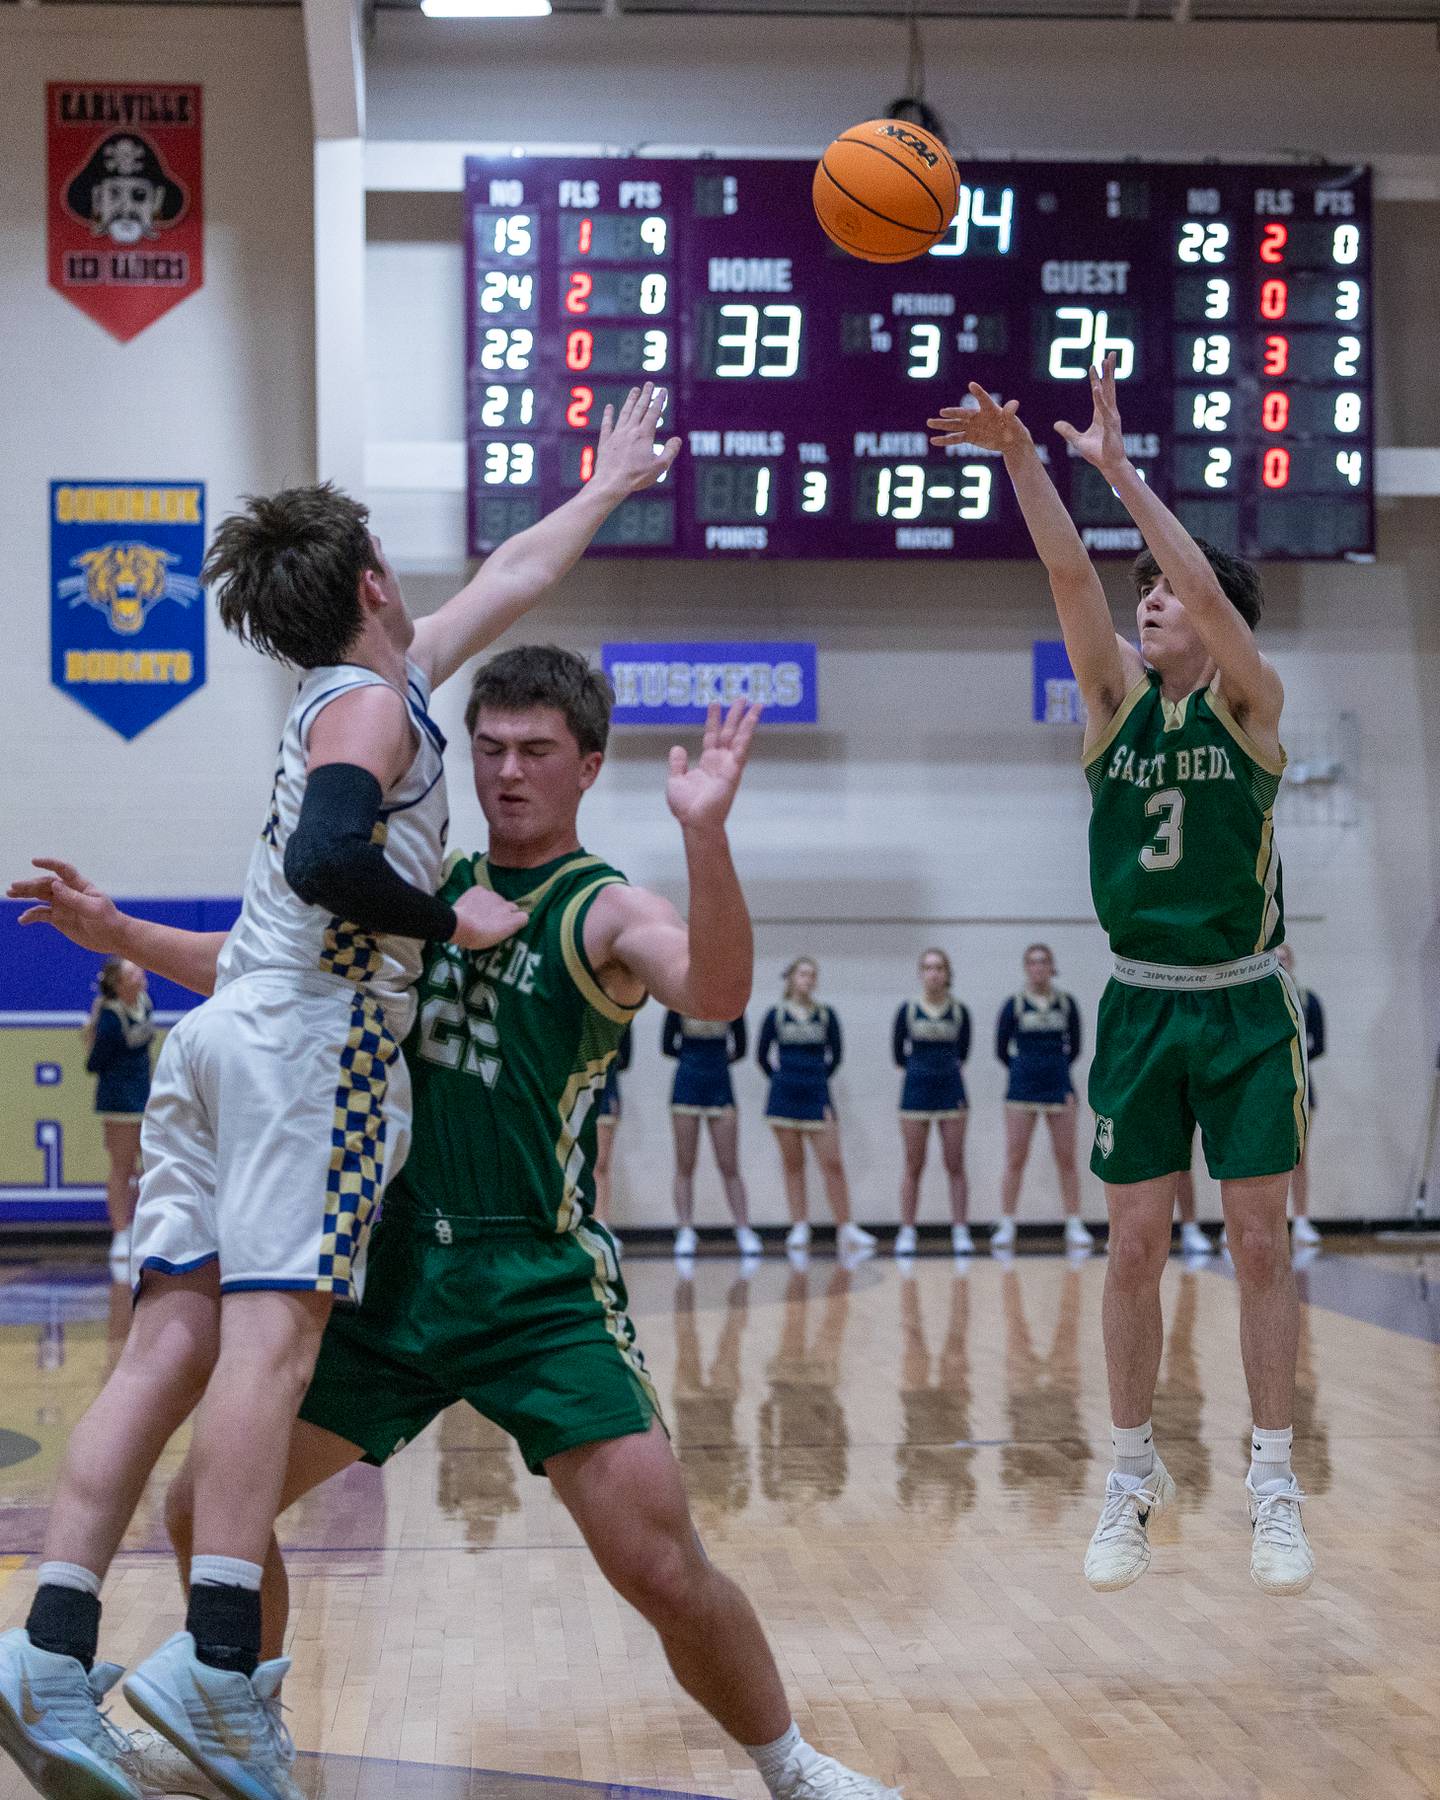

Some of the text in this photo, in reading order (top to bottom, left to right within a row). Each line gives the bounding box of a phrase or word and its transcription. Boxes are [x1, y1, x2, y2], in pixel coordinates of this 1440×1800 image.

[876, 124, 939, 169] NCAA
[489, 179, 524, 208] NO
[559, 179, 600, 209] FLS
[619, 181, 662, 209] PTS
[1186, 187, 1221, 214] NO
[1254, 188, 1294, 215] FLS
[1314, 189, 1355, 215] PTS
[494, 215, 531, 256] 15
[578, 218, 592, 254] 1
[641, 217, 666, 255] 9
[1178, 223, 1229, 263] 22
[1260, 223, 1287, 263] 2
[1333, 225, 1359, 264] 0
[481, 272, 533, 313] 24
[565, 272, 592, 313] 2
[640, 274, 667, 315] 0
[708, 257, 793, 292] HOME
[1041, 260, 1130, 294] GUEST
[892, 293, 955, 317] PERIOD
[1205, 279, 1230, 319] 3
[1261, 279, 1287, 320] 0
[1335, 280, 1360, 320] 3
[481, 329, 533, 370] 22
[566, 329, 593, 371] 0
[642, 330, 667, 371] 3
[716, 305, 802, 377] 33
[908, 324, 940, 378] 3
[1048, 307, 1135, 380] 26
[1192, 335, 1230, 375] 13
[1264, 336, 1288, 376] 3
[1334, 336, 1360, 376] 2
[482, 386, 534, 427] 21
[566, 386, 593, 427] 2
[1193, 391, 1231, 431] 12
[1262, 391, 1289, 432] 0
[1334, 392, 1361, 432] 8
[484, 443, 534, 484] 33
[580, 445, 593, 482] 1
[689, 431, 785, 457] TM FOULS
[853, 431, 928, 457] PLAYER
[1205, 447, 1231, 488] 2
[1263, 447, 1289, 488] 0
[1336, 451, 1361, 486] 4
[755, 466, 770, 516] 1
[802, 471, 827, 512] 3
[705, 526, 768, 549] POINTS
[1082, 527, 1143, 550] POINTS
[65, 650, 193, 684] BOBCATS
[610, 661, 804, 707] HUSKERS
[1137, 786, 1186, 872] 3
[1213, 957, 1270, 981] DYNAMIC
[417, 956, 502, 1090] 22
